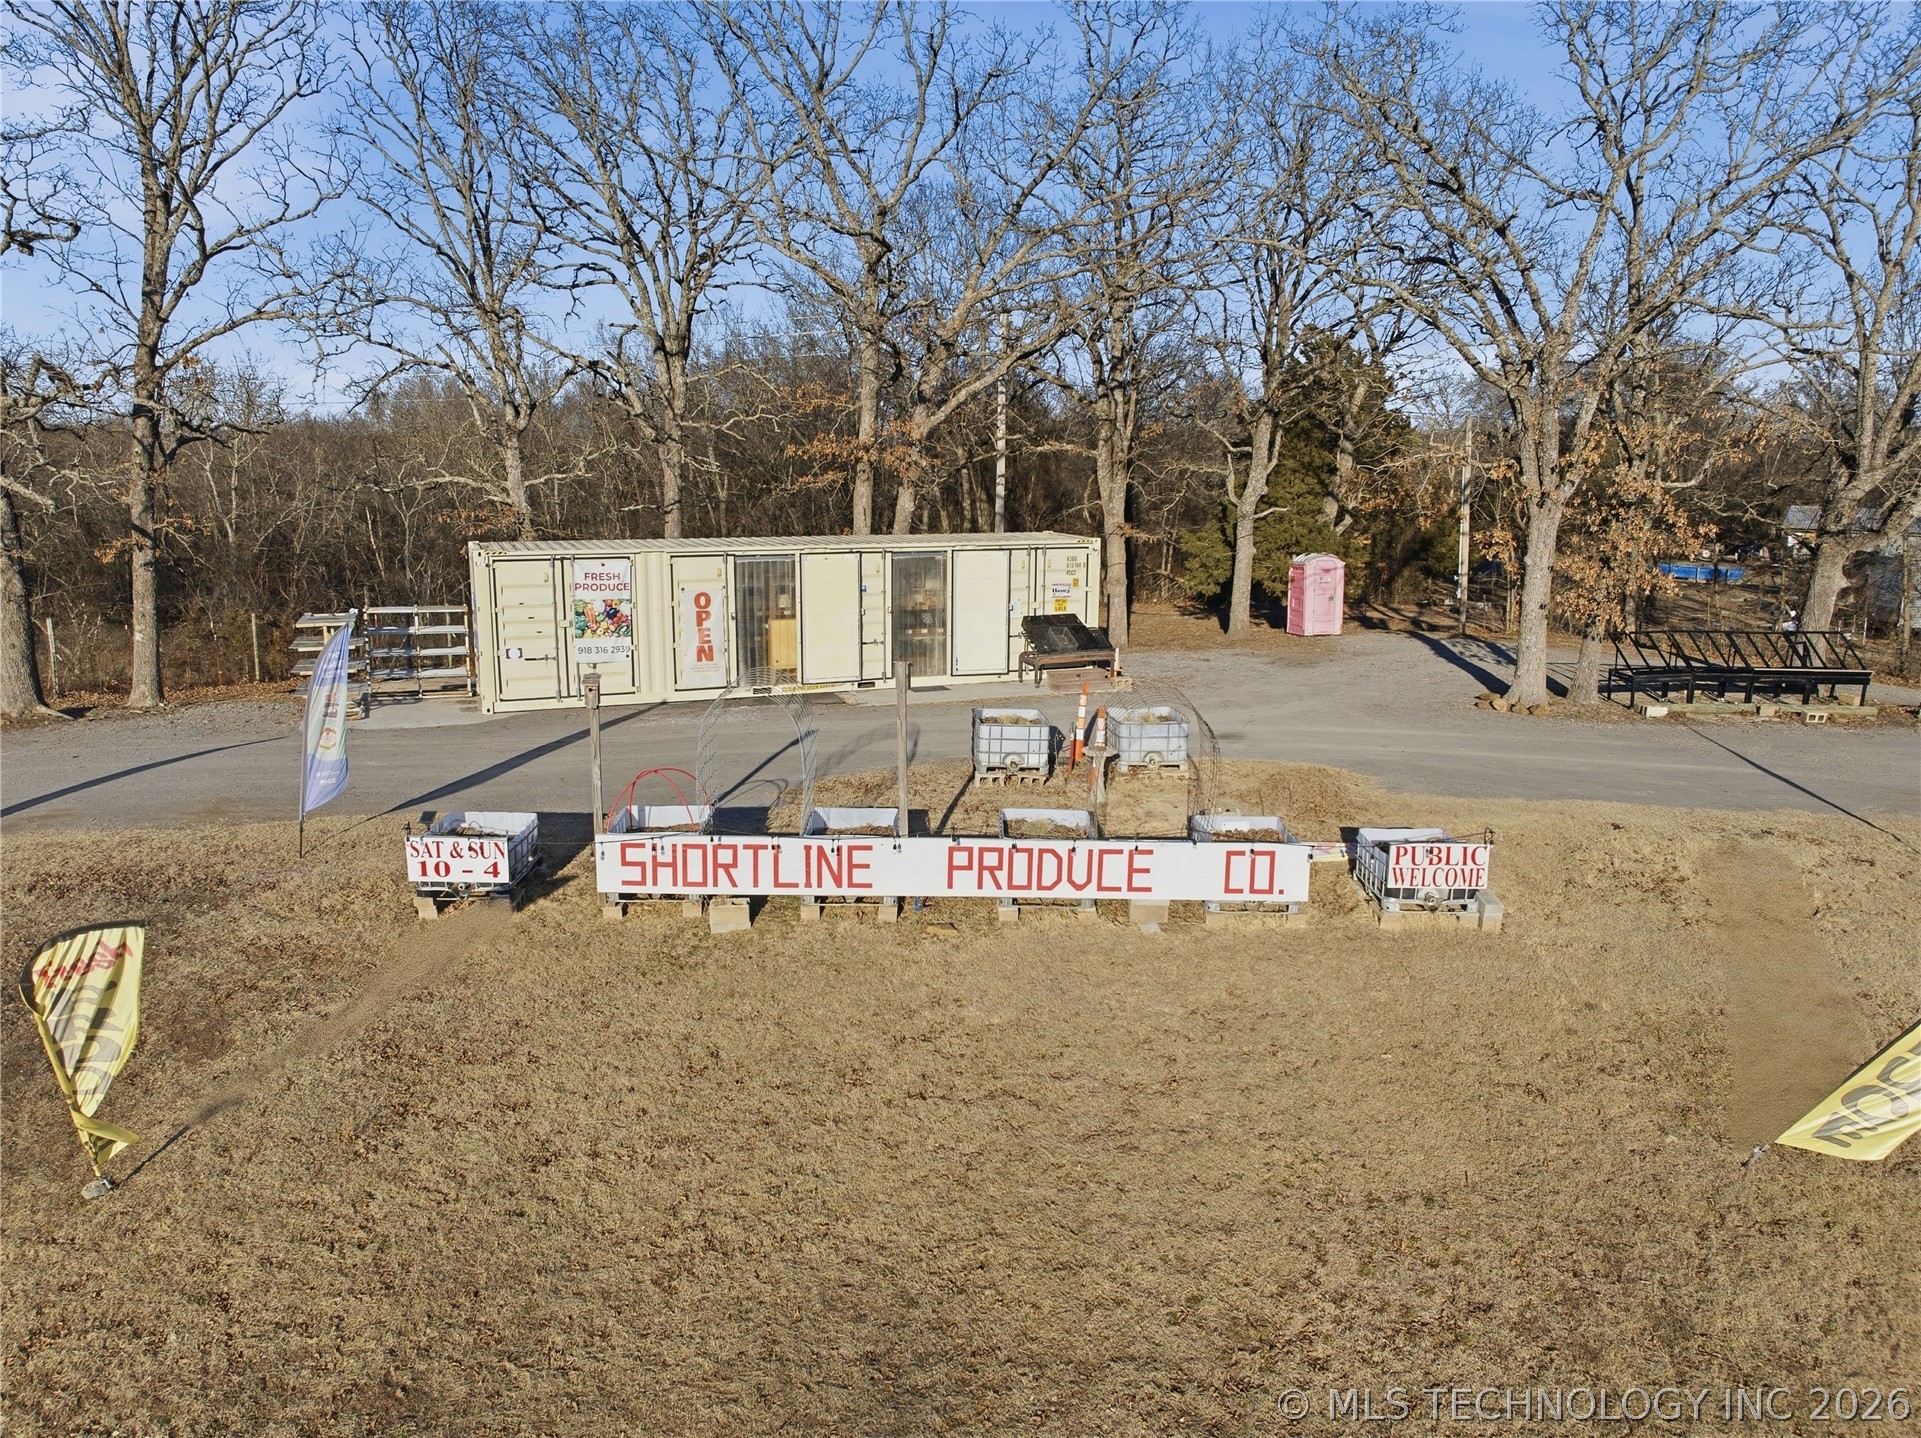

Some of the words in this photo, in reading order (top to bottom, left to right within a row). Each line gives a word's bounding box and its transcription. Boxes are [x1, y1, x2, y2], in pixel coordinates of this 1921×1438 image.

[584, 573, 620, 581] FRESH
[575, 583, 630, 591] PRODUCE
[694, 592, 714, 662] OPEN
[595, 646, 609, 654] 316
[611, 645, 631, 653] 2939
[410, 841, 444, 858] SAT
[449, 841, 464, 859] &
[468, 841, 505, 859] SUN
[1394, 845, 1488, 866] PUBLIC
[418, 860, 451, 877] 10
[483, 861, 501, 878] 4
[620, 842, 873, 889] SHORTLINE
[947, 846, 1153, 893] PRODUCE
[1224, 850, 1284, 895] CO.
[1392, 867, 1485, 887] WELCOME
